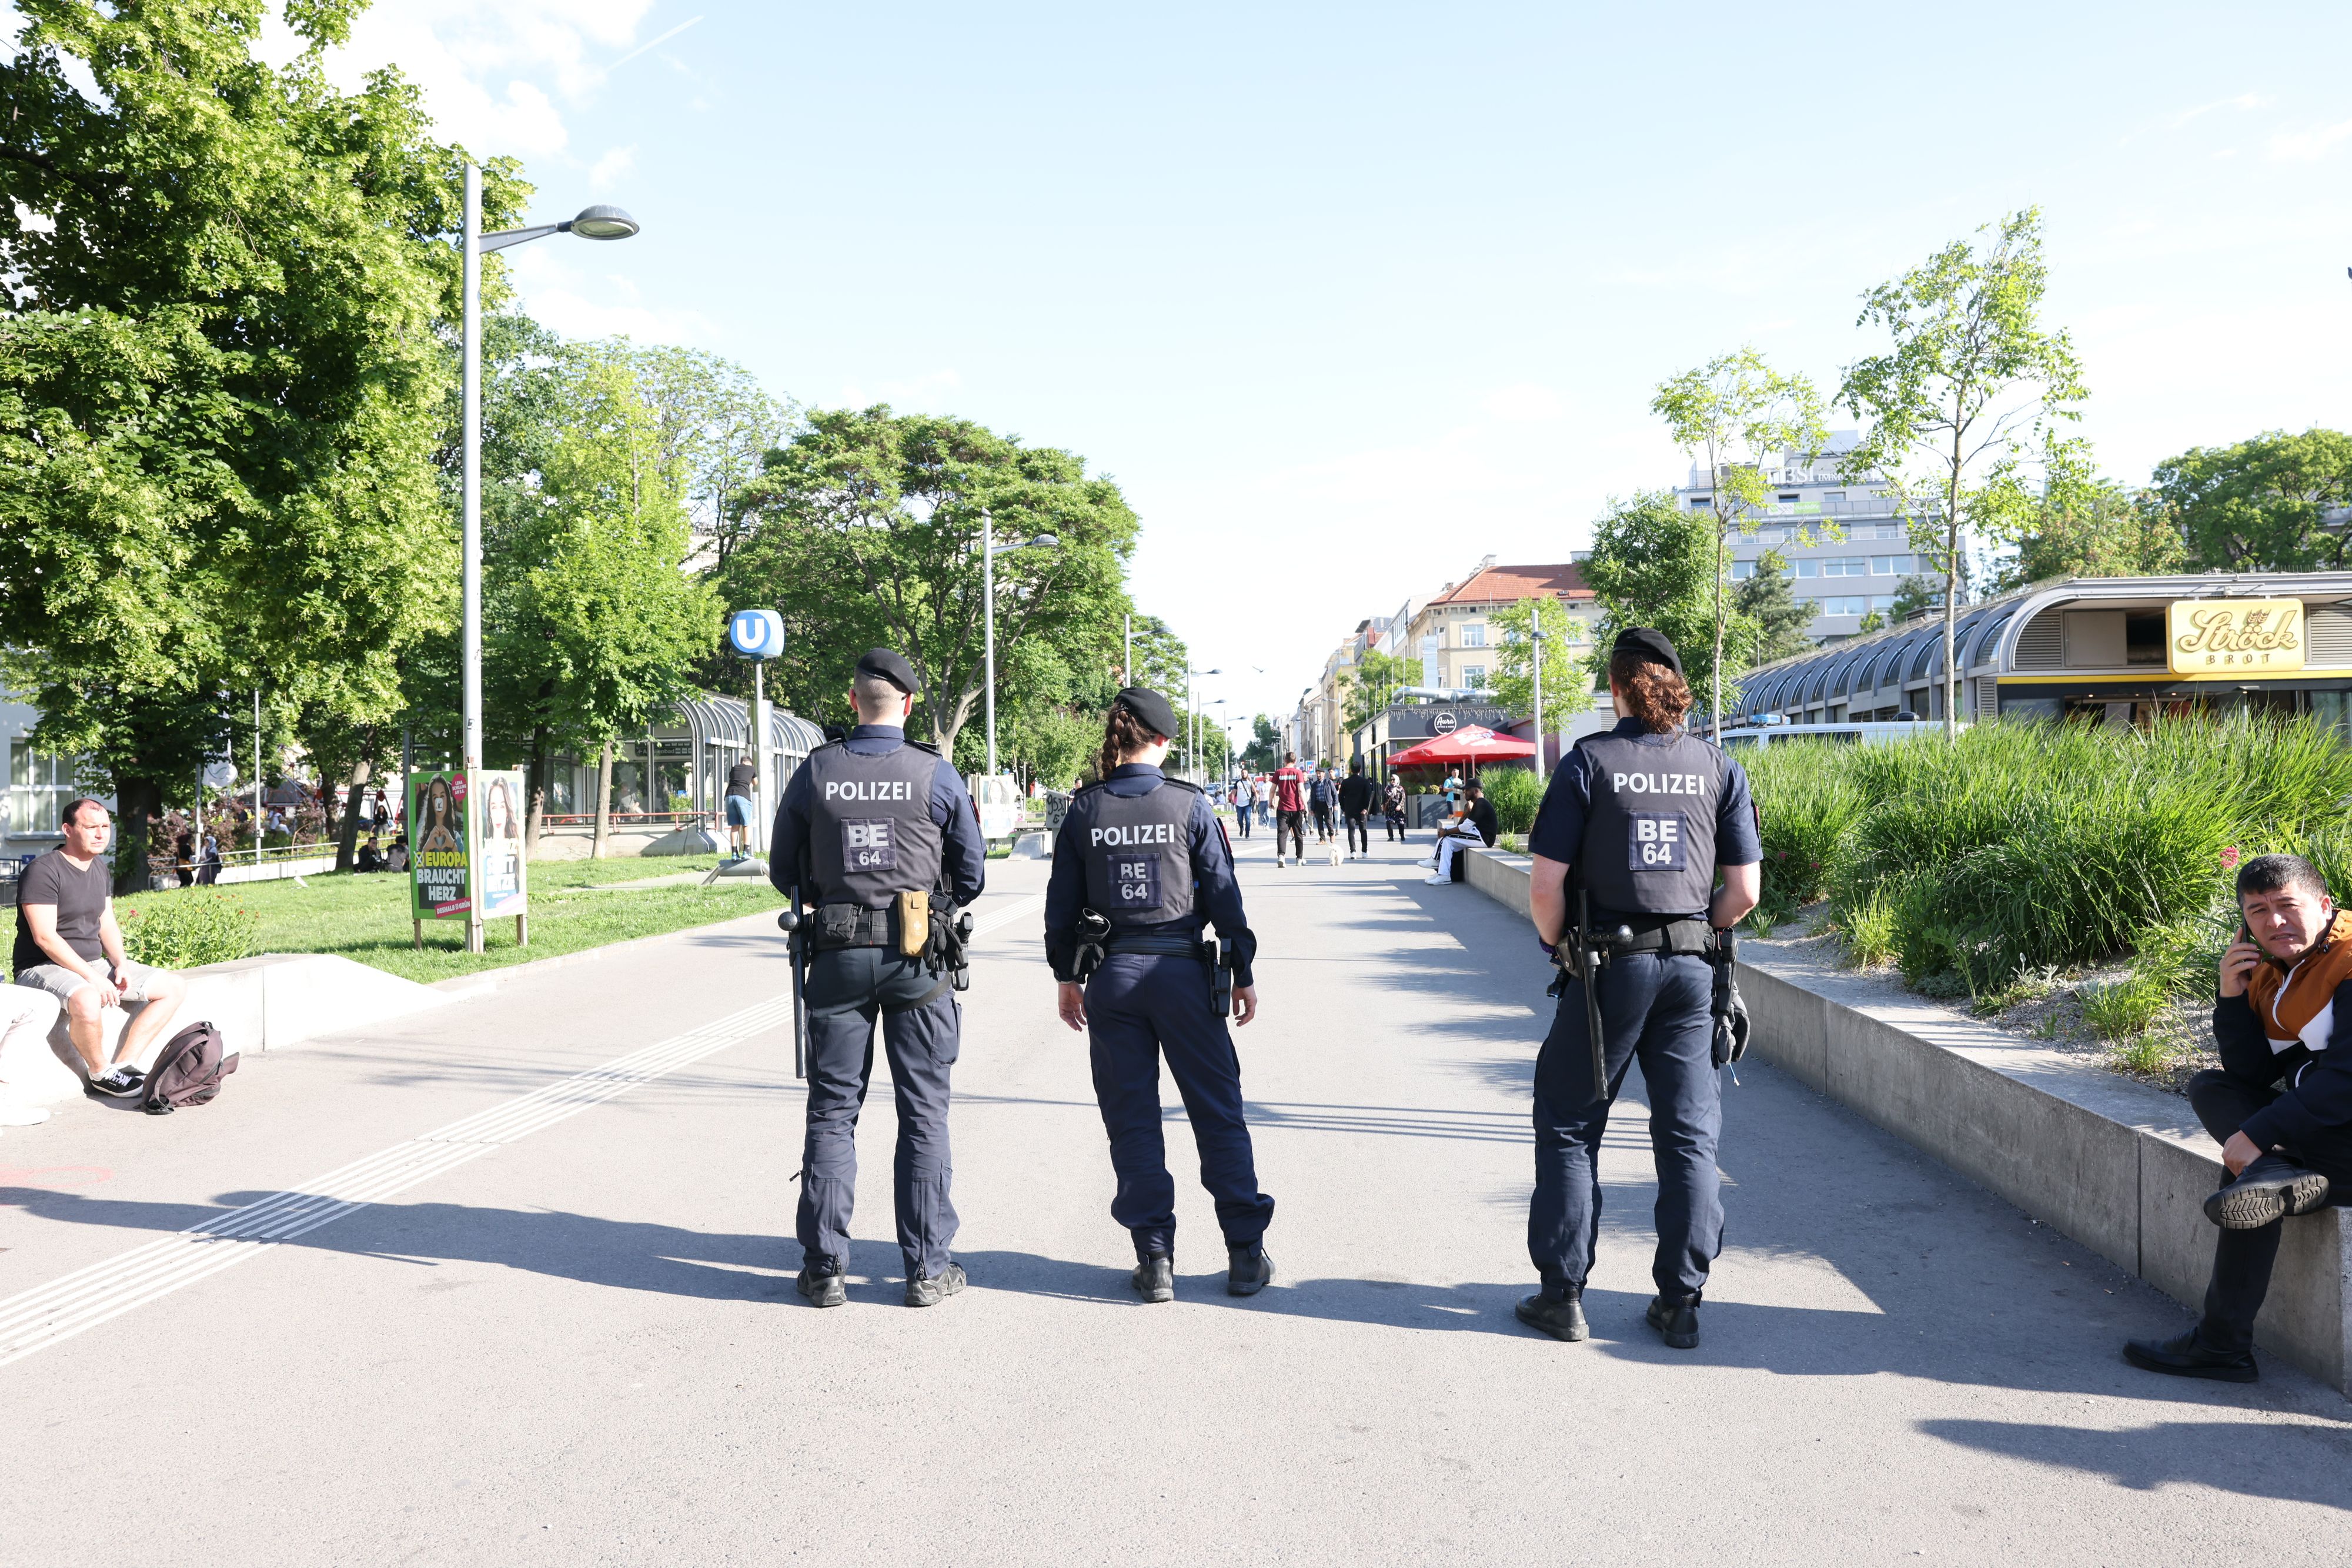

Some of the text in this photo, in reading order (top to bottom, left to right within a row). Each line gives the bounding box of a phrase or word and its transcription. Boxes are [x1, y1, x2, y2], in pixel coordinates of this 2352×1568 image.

[737, 618, 764, 649] U
[2177, 610, 2298, 652] Ströck
[2209, 654, 2270, 664] BROT
[1436, 717, 1455, 726] Aura
[826, 781, 911, 800] POLIZEI
[1613, 773, 1705, 795] POLIZEI
[848, 824, 889, 848] BE
[1091, 824, 1175, 847] POLIZEI
[1637, 820, 1678, 842] BE
[426, 851, 468, 867] EUROPA
[859, 851, 881, 866] 64
[1642, 842, 1672, 864] 64
[416, 869, 466, 884] BRAUCHT
[1120, 862, 1147, 880] BE
[428, 886, 456, 901] HERZ
[1121, 883, 1148, 900] 64
[436, 901, 470, 915] DESHALB GRÜN
